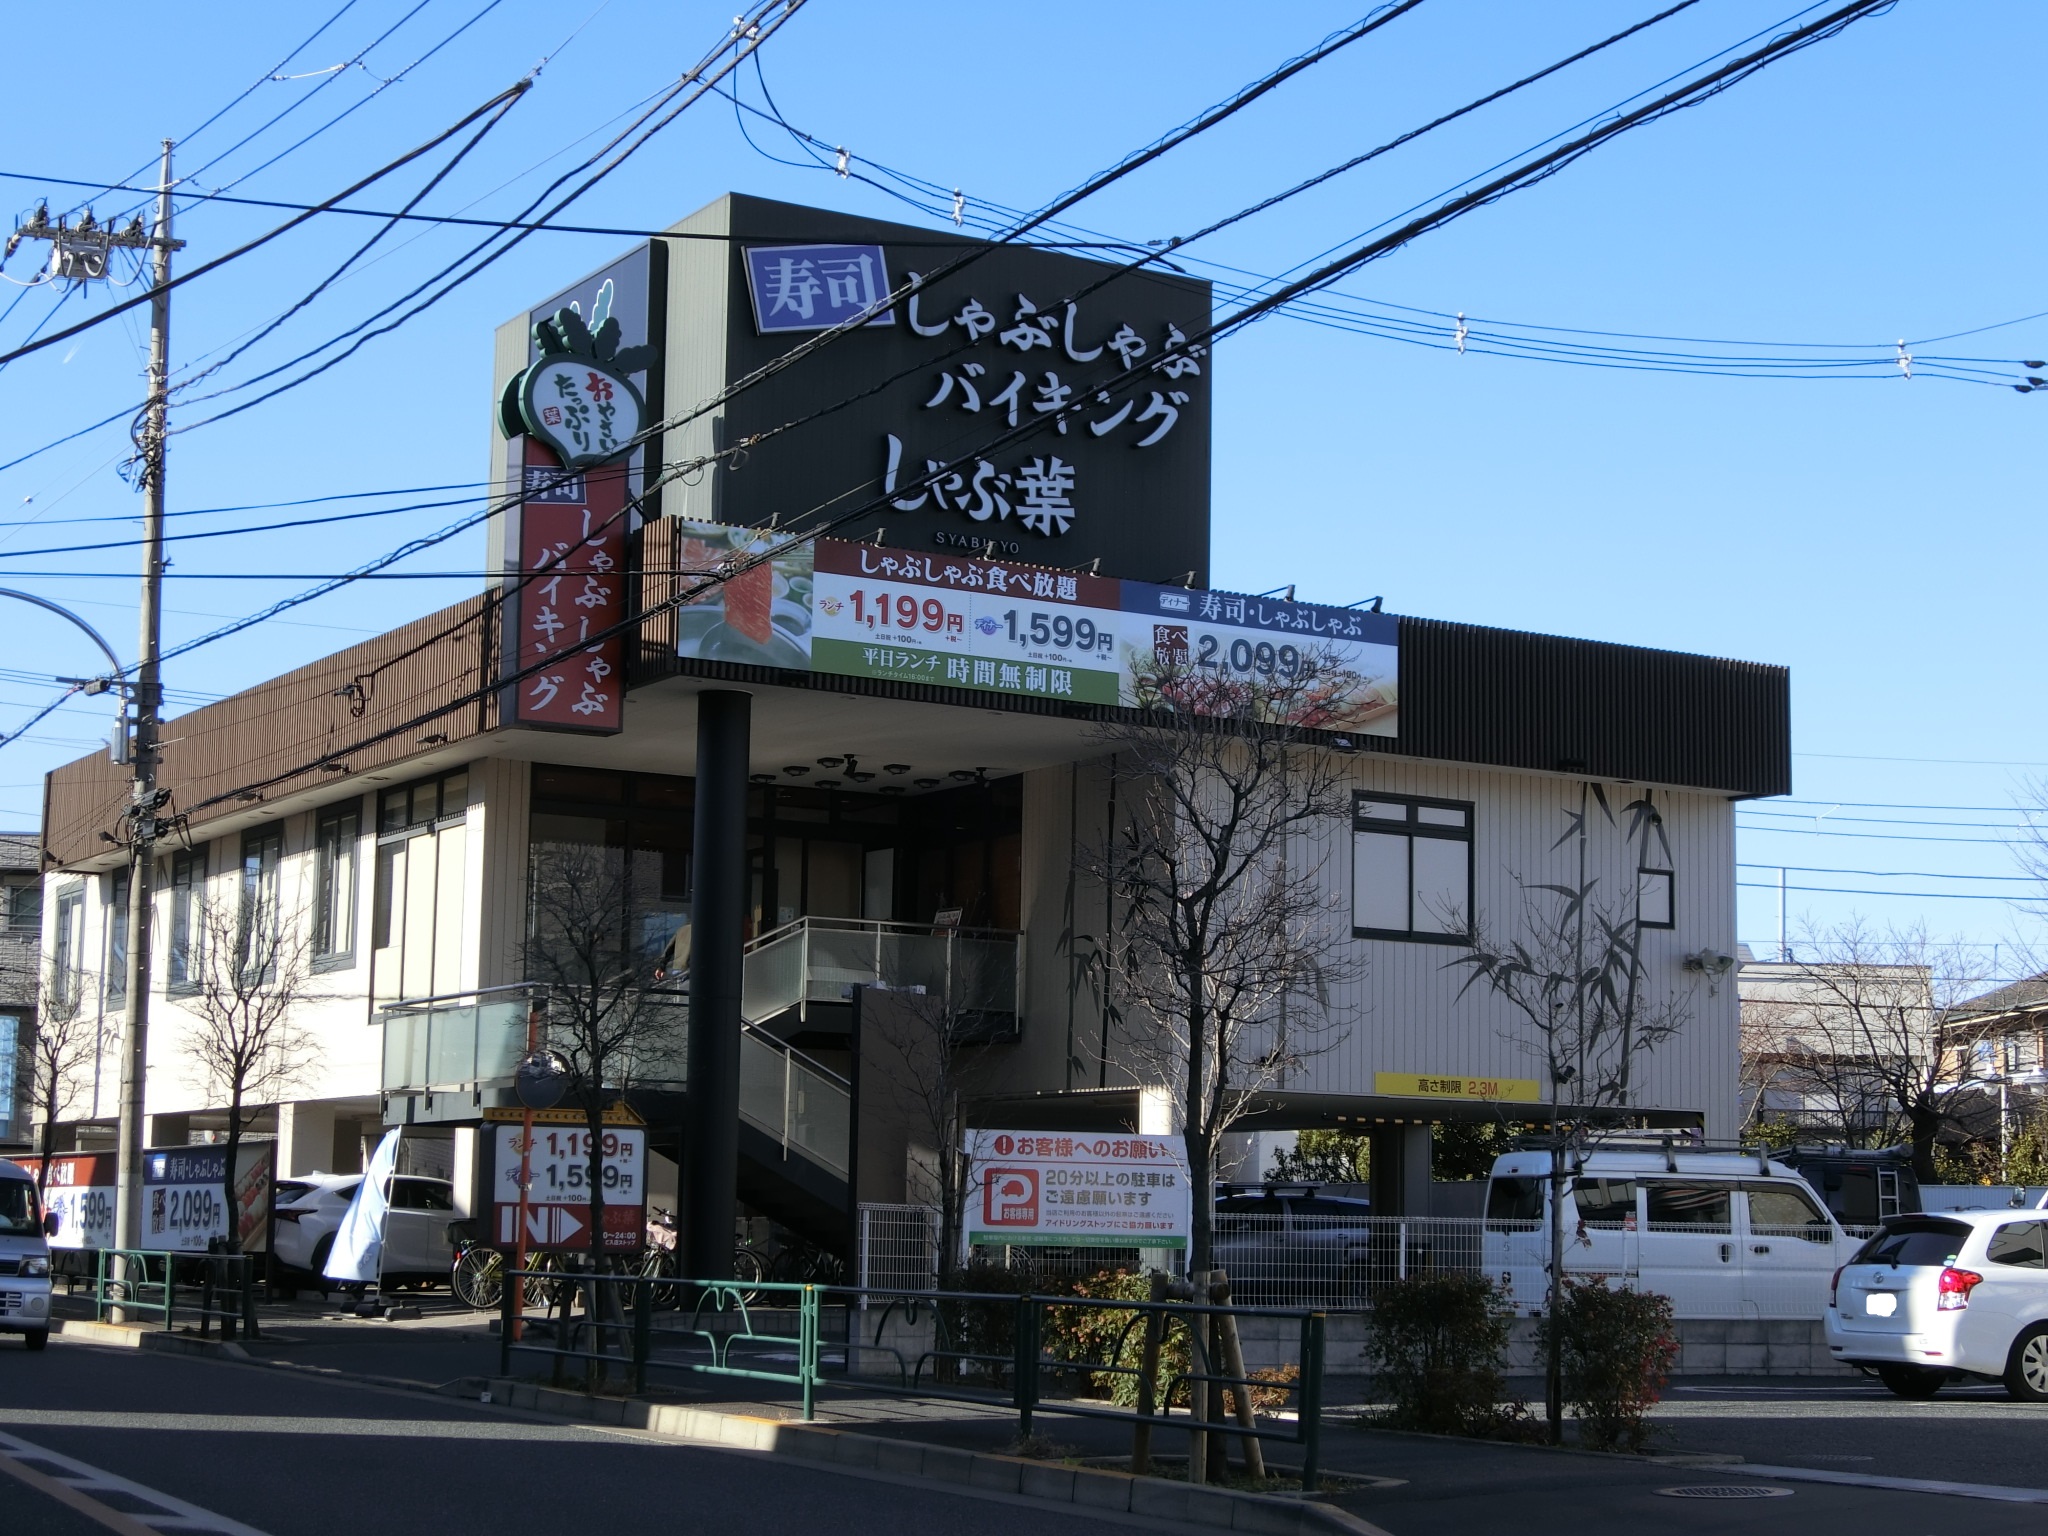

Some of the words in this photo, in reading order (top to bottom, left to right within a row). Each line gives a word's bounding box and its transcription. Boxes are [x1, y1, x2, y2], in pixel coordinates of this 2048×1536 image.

[764, 253, 875, 320] 寿司
[907, 271, 1208, 380] しゃぶしゃぶ
[554, 374, 590, 452] たっぷり
[585, 372, 618, 453] おやさい
[925, 363, 1190, 449] バイキング
[525, 470, 579, 500] 寿司
[884, 433, 1077, 538] しゃぶ葉
[859, 549, 1078, 600] しゃぶしゃぶ食べ放題
[571, 509, 614, 716] しゃぶしゃぶ
[819, 600, 844, 612] ランチ
[849, 590, 964, 633] 1,199円
[1161, 595, 1190, 607] ディナー
[1199, 593, 1362, 637] 寿司・しゃぶしゃぶ
[974, 618, 1003, 630] ディナー
[1003, 609, 1113, 652] 1,599円
[1154, 626, 1188, 645] 食べ
[862, 647, 941, 672] 平日ランチ
[947, 657, 1073, 695] 時間無制限
[1155, 646, 1188, 666] 放題
[1418, 1078, 1462, 1094] 高さ制限
[1468, 1081, 1498, 1096] 2.3M
[546, 1132, 633, 1159] 1,199円
[1017, 1137, 1170, 1159] お客様へのお願い
[505, 1168, 540, 1182] ディー
[1045, 1169, 1176, 1188] 20分以上の駐車は
[169, 1189, 221, 1236] 2,099円
[1003, 1207, 1034, 1220] お客様専用
[1045, 1190, 1152, 1206] ご遠慮願います
[500, 1206, 549, 1243] IN
[1045, 1219, 1174, 1230] アイドリングストップにご協力願います
